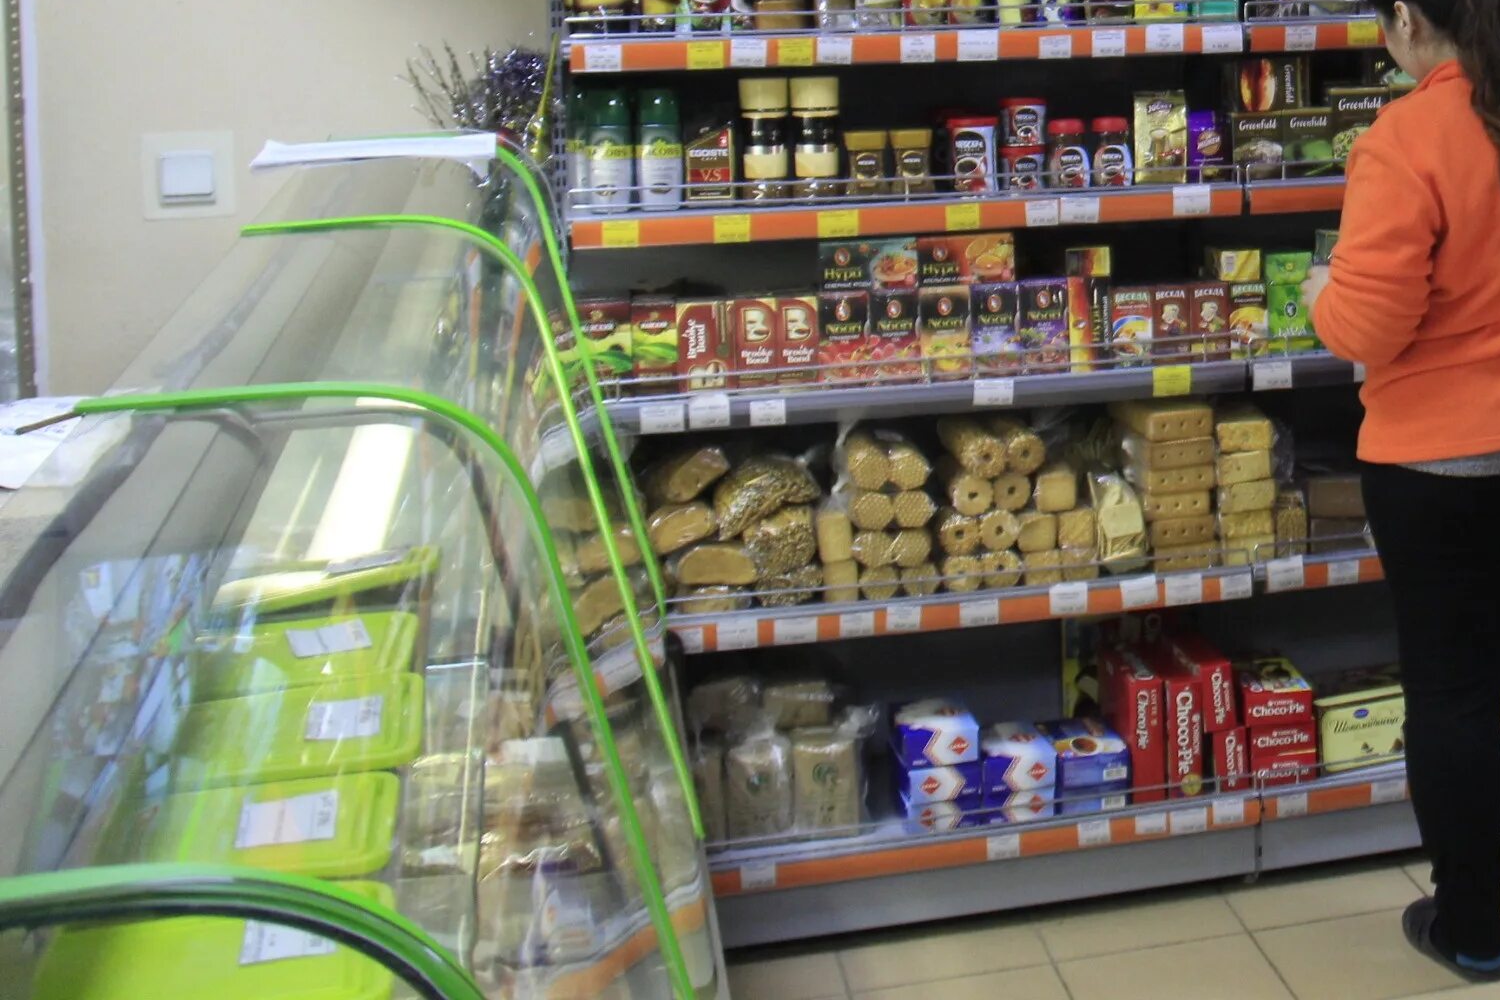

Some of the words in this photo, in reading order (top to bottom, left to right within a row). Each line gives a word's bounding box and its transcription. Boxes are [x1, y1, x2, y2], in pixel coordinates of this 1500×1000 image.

[1284, 64, 1295, 103] Greenfield
[1338, 96, 1382, 112] Greenfield
[1238, 117, 1277, 132] Greenfield
[1289, 115, 1328, 129] Greenfield
[1155, 288, 1186, 300] БЕСЕДА
[1193, 287, 1225, 298] БЕСЕДА
[1136, 690, 1151, 729] Choco
